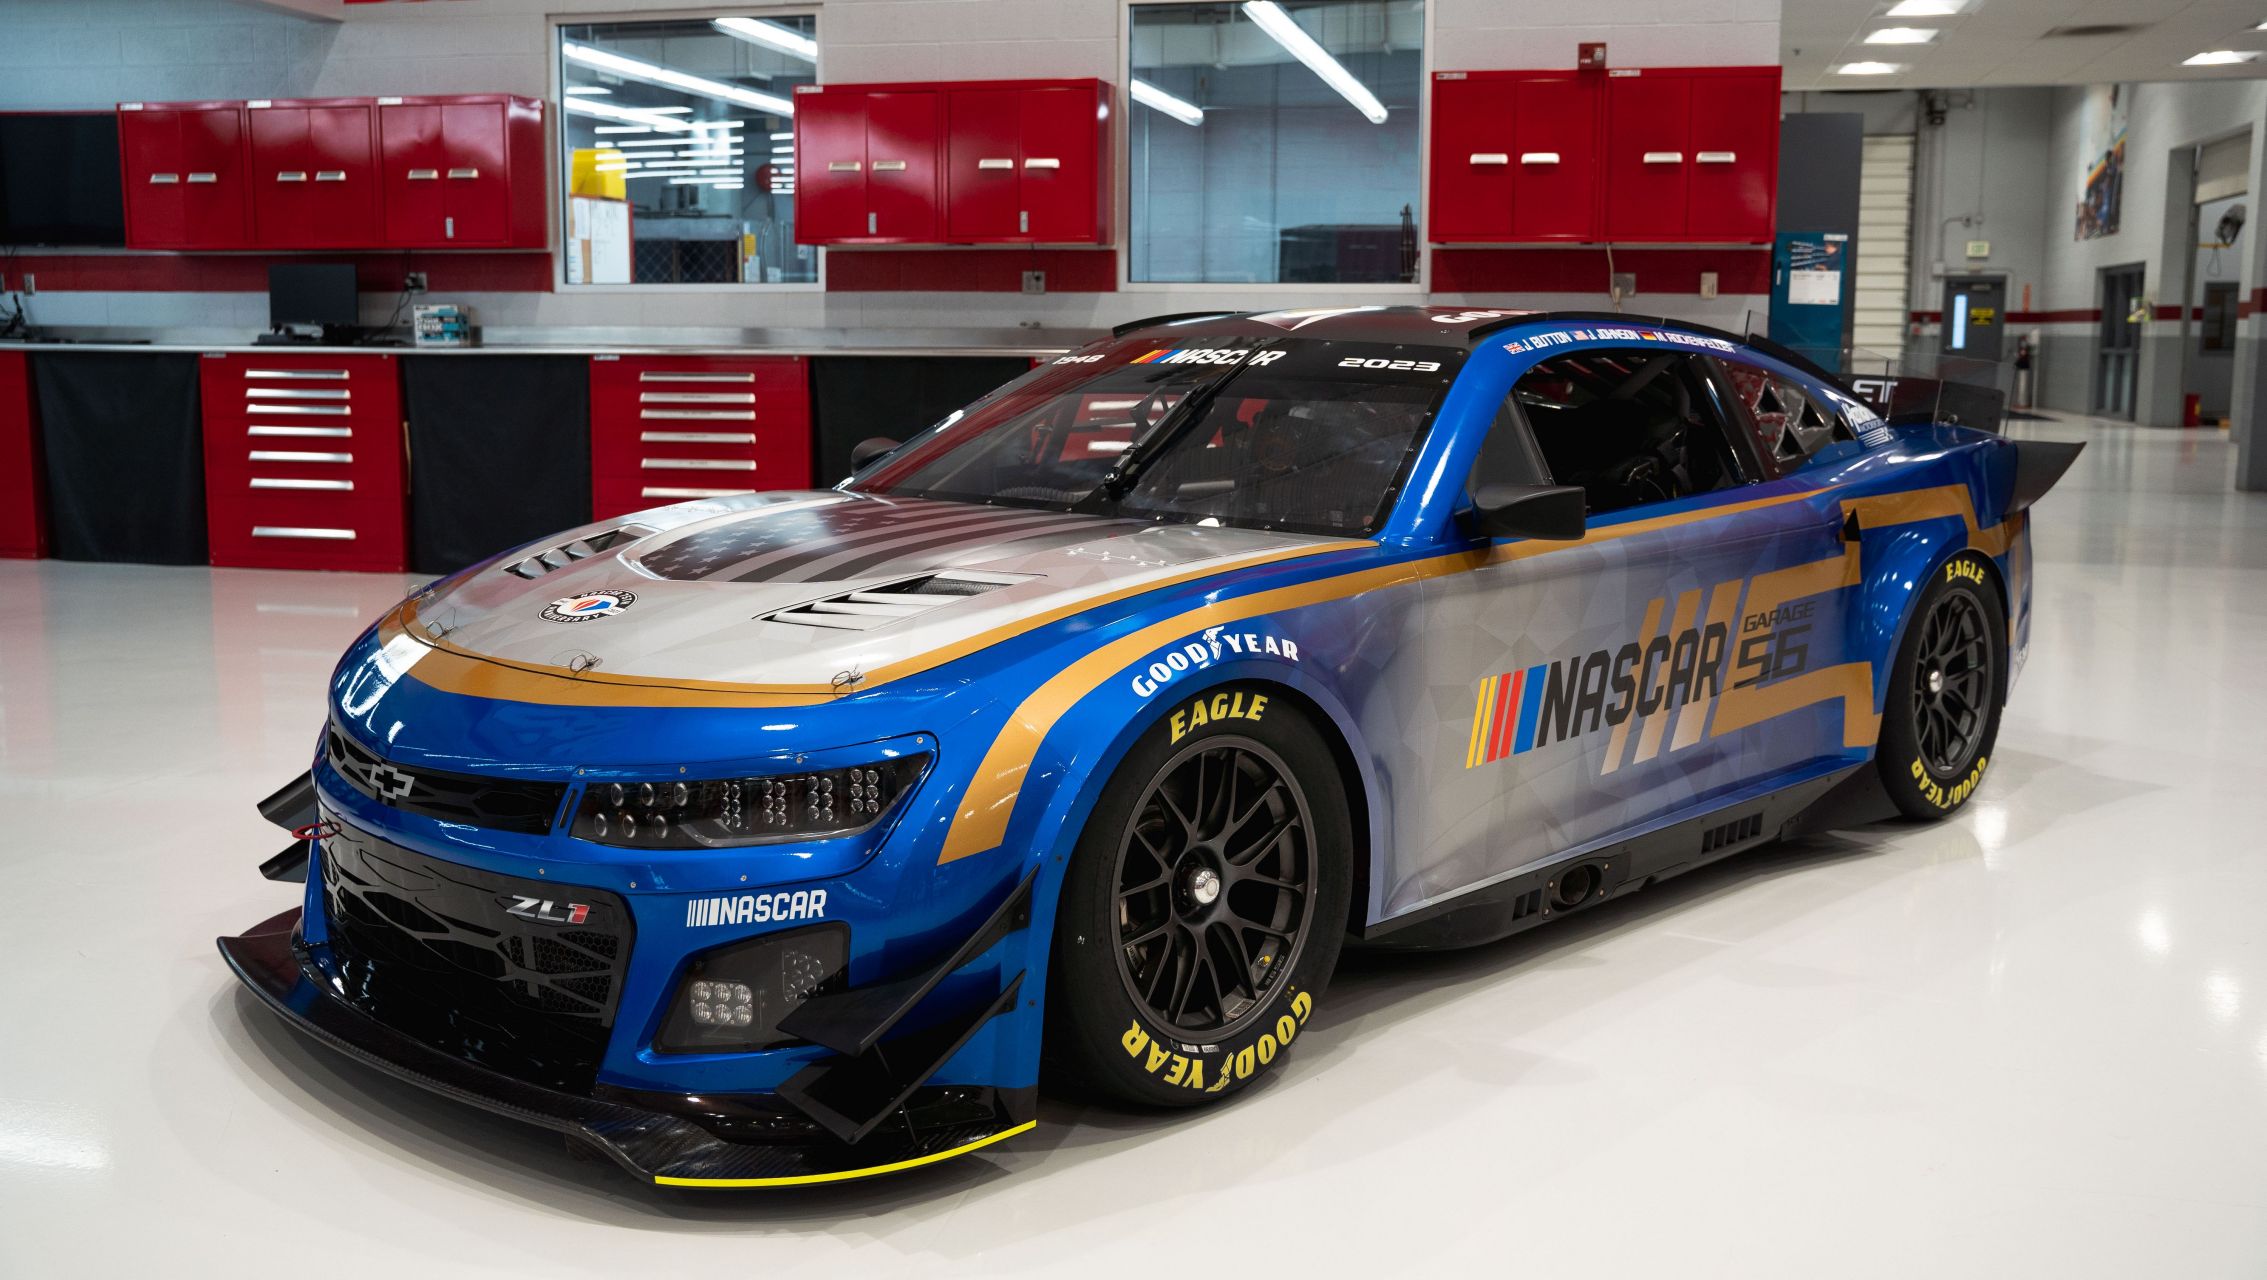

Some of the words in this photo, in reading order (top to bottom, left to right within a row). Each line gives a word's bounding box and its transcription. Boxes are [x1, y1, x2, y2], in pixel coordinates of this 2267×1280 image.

[1529, 331, 1572, 348] BUTTON
[1595, 328, 1640, 340] JOHNSON
[1052, 354, 1105, 365] 1948
[1338, 357, 1441, 372] 2023
[1946, 560, 1984, 585] EAGLE
[1743, 601, 1816, 632] GARAGE
[1734, 624, 1812, 690] 56
[1536, 622, 1727, 748] NASCAR
[1170, 691, 1269, 746] EAGLE
[506, 894, 591, 925] ZL1
[717, 889, 827, 925] NASCAR
